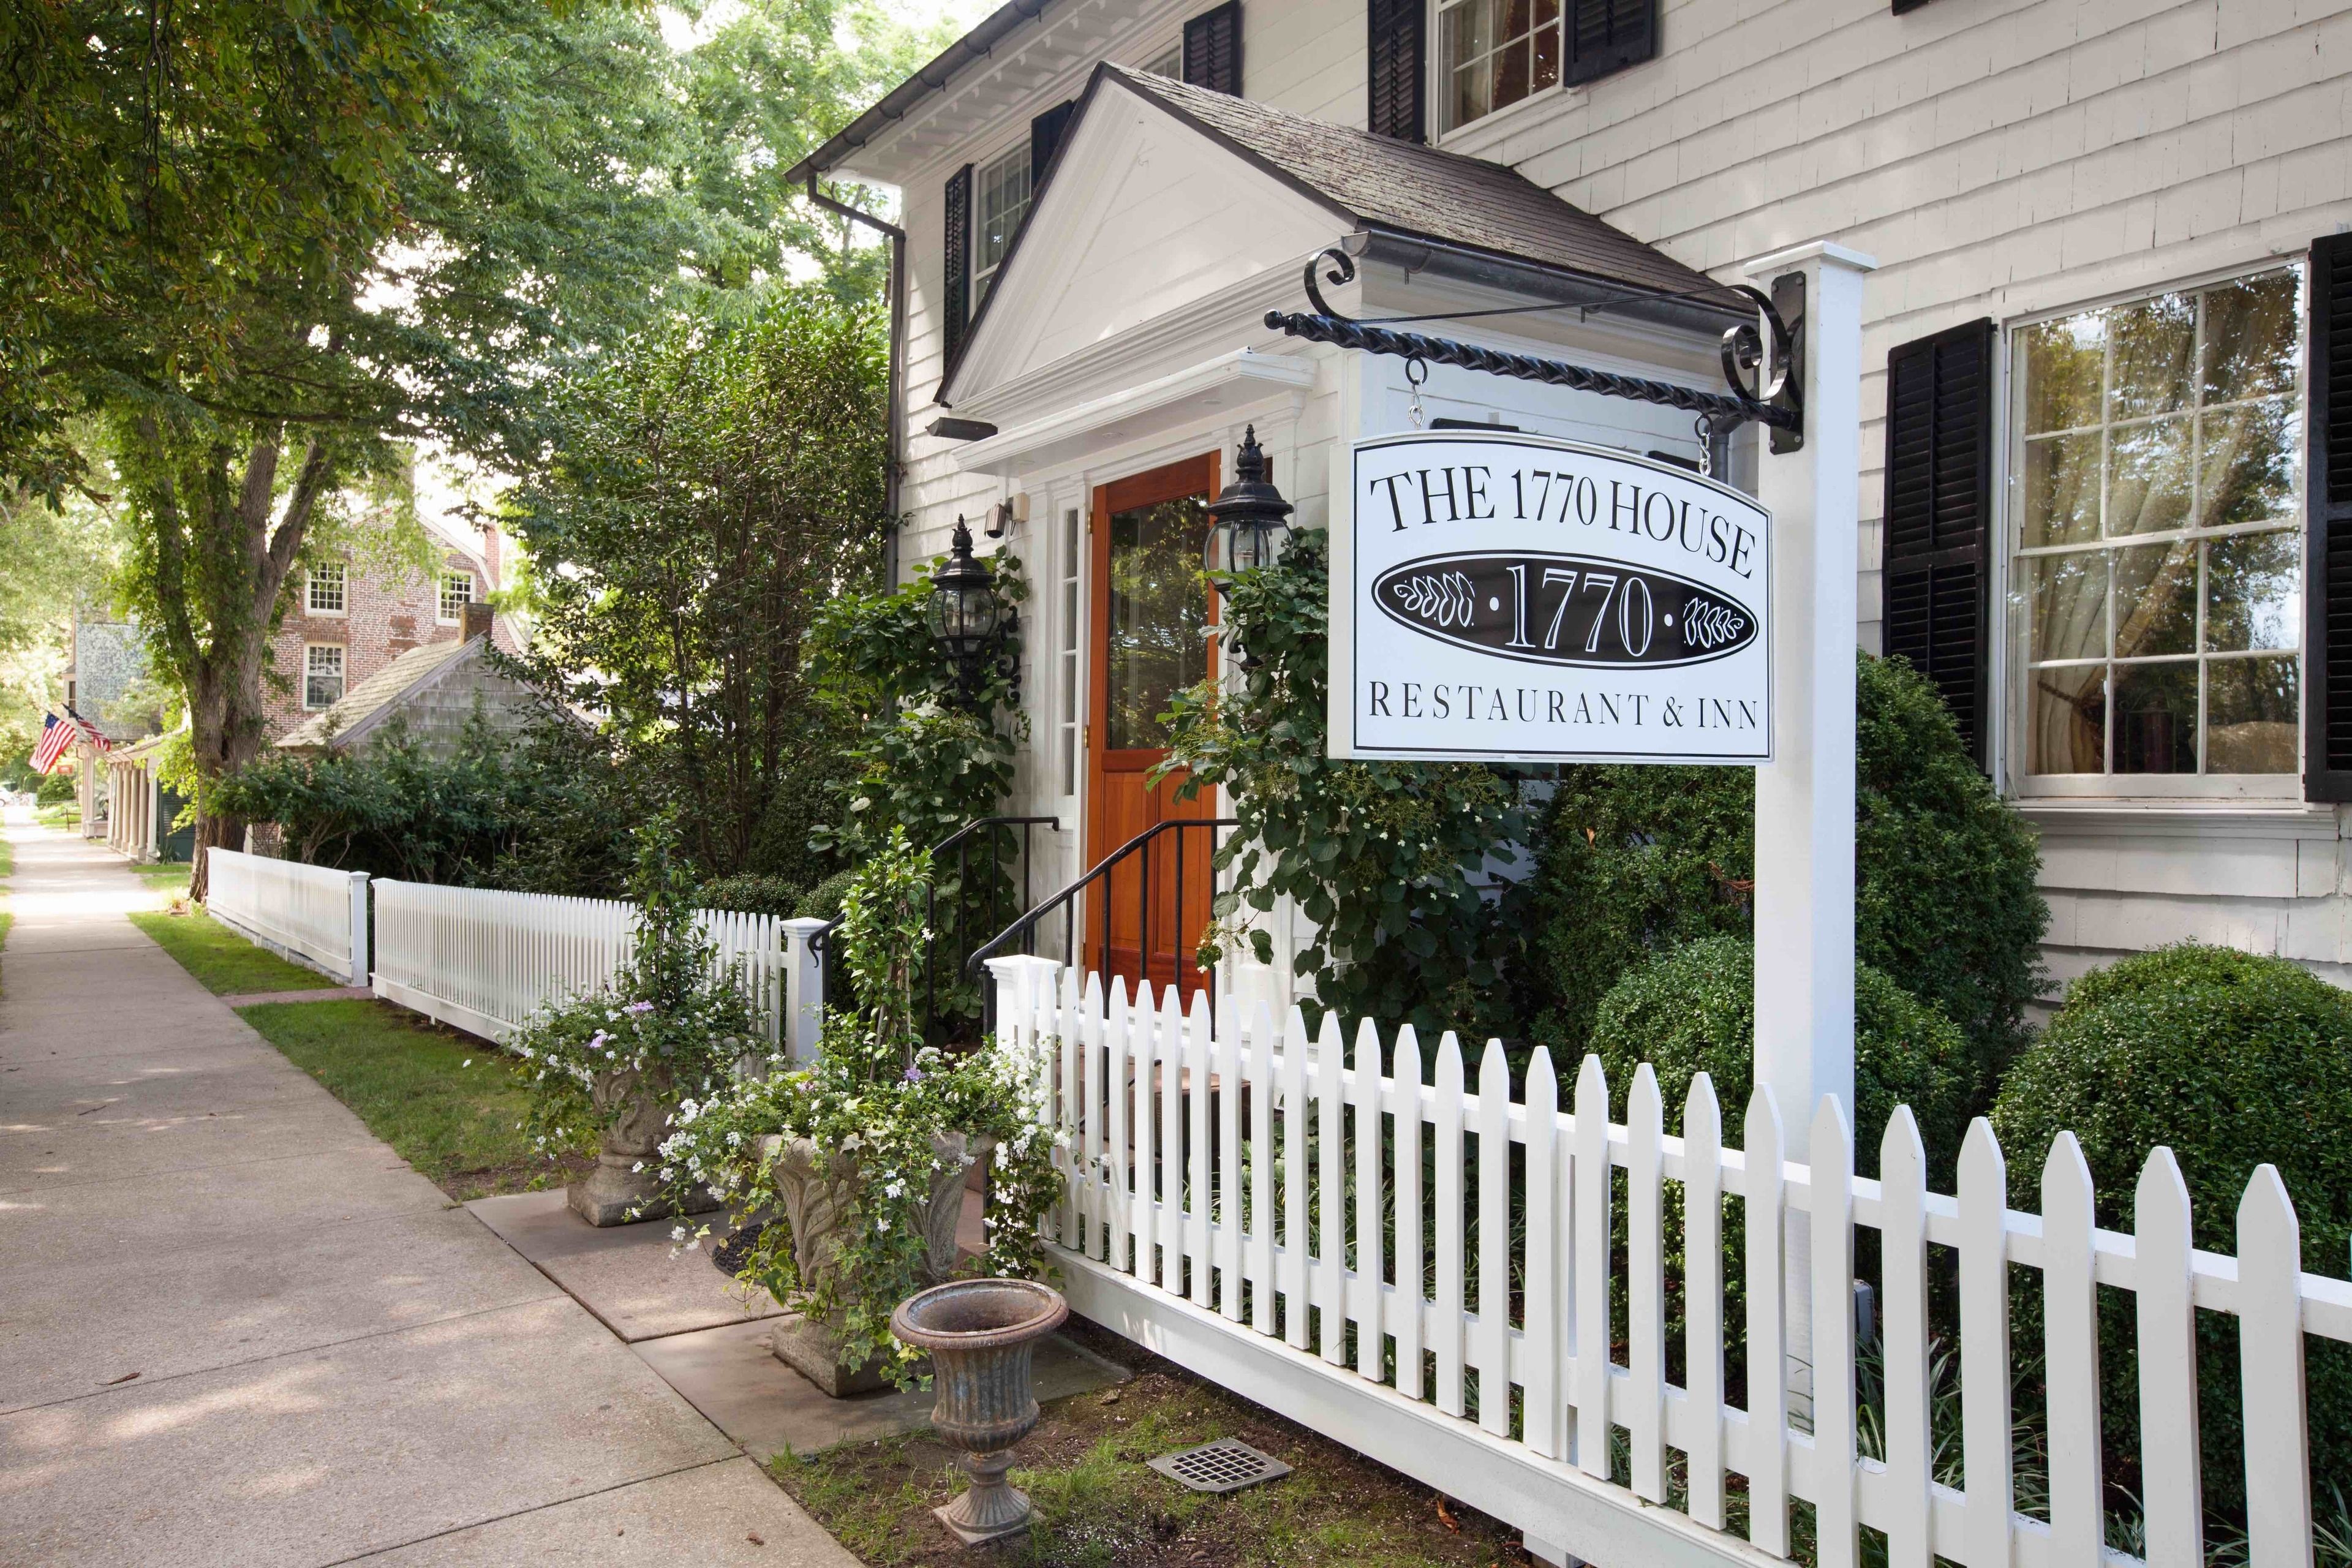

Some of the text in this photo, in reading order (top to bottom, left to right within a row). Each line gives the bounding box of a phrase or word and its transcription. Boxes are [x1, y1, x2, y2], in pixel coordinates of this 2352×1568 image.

[1370, 466, 1756, 579] THE 1770 HOUSE
[1505, 564, 1653, 657] 1770
[1370, 681, 1758, 729] RESTAURANT & INN
